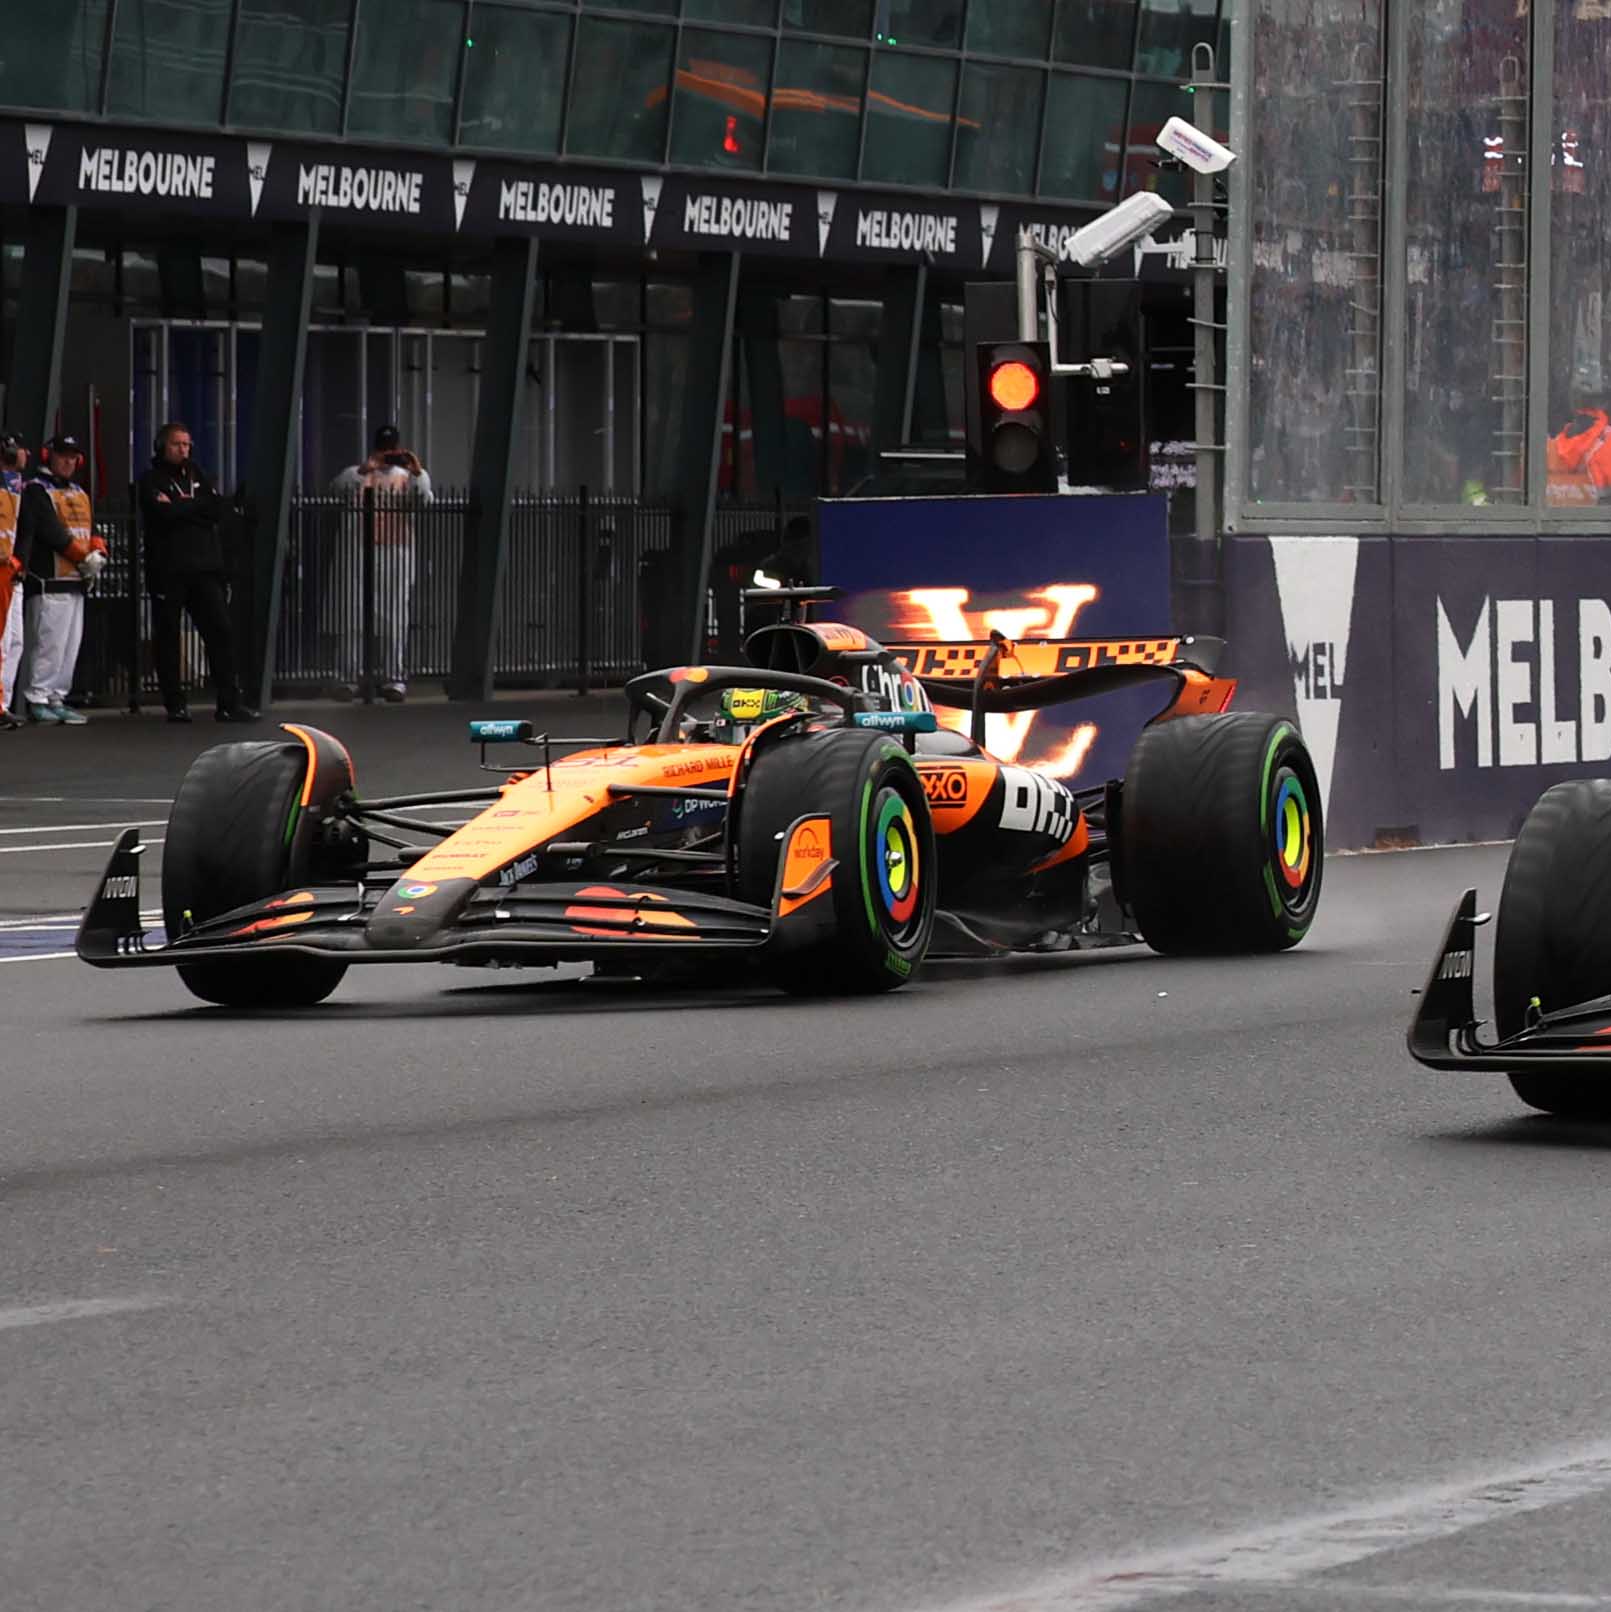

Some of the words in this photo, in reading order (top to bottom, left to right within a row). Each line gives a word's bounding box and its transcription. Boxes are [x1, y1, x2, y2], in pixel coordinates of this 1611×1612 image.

[78, 145, 215, 199] MELBOURNE
[297, 163, 423, 214] MELBOURNE
[499, 178, 615, 229] MELBOURNE
[684, 194, 793, 242] MELBOURNE
[856, 208, 957, 254] MELBOURNE
[1288, 641, 1342, 700] MEL
[861, 715, 905, 728] allwyn
[479, 723, 515, 738] allwyn
[706, 754, 735, 770] MILLE
